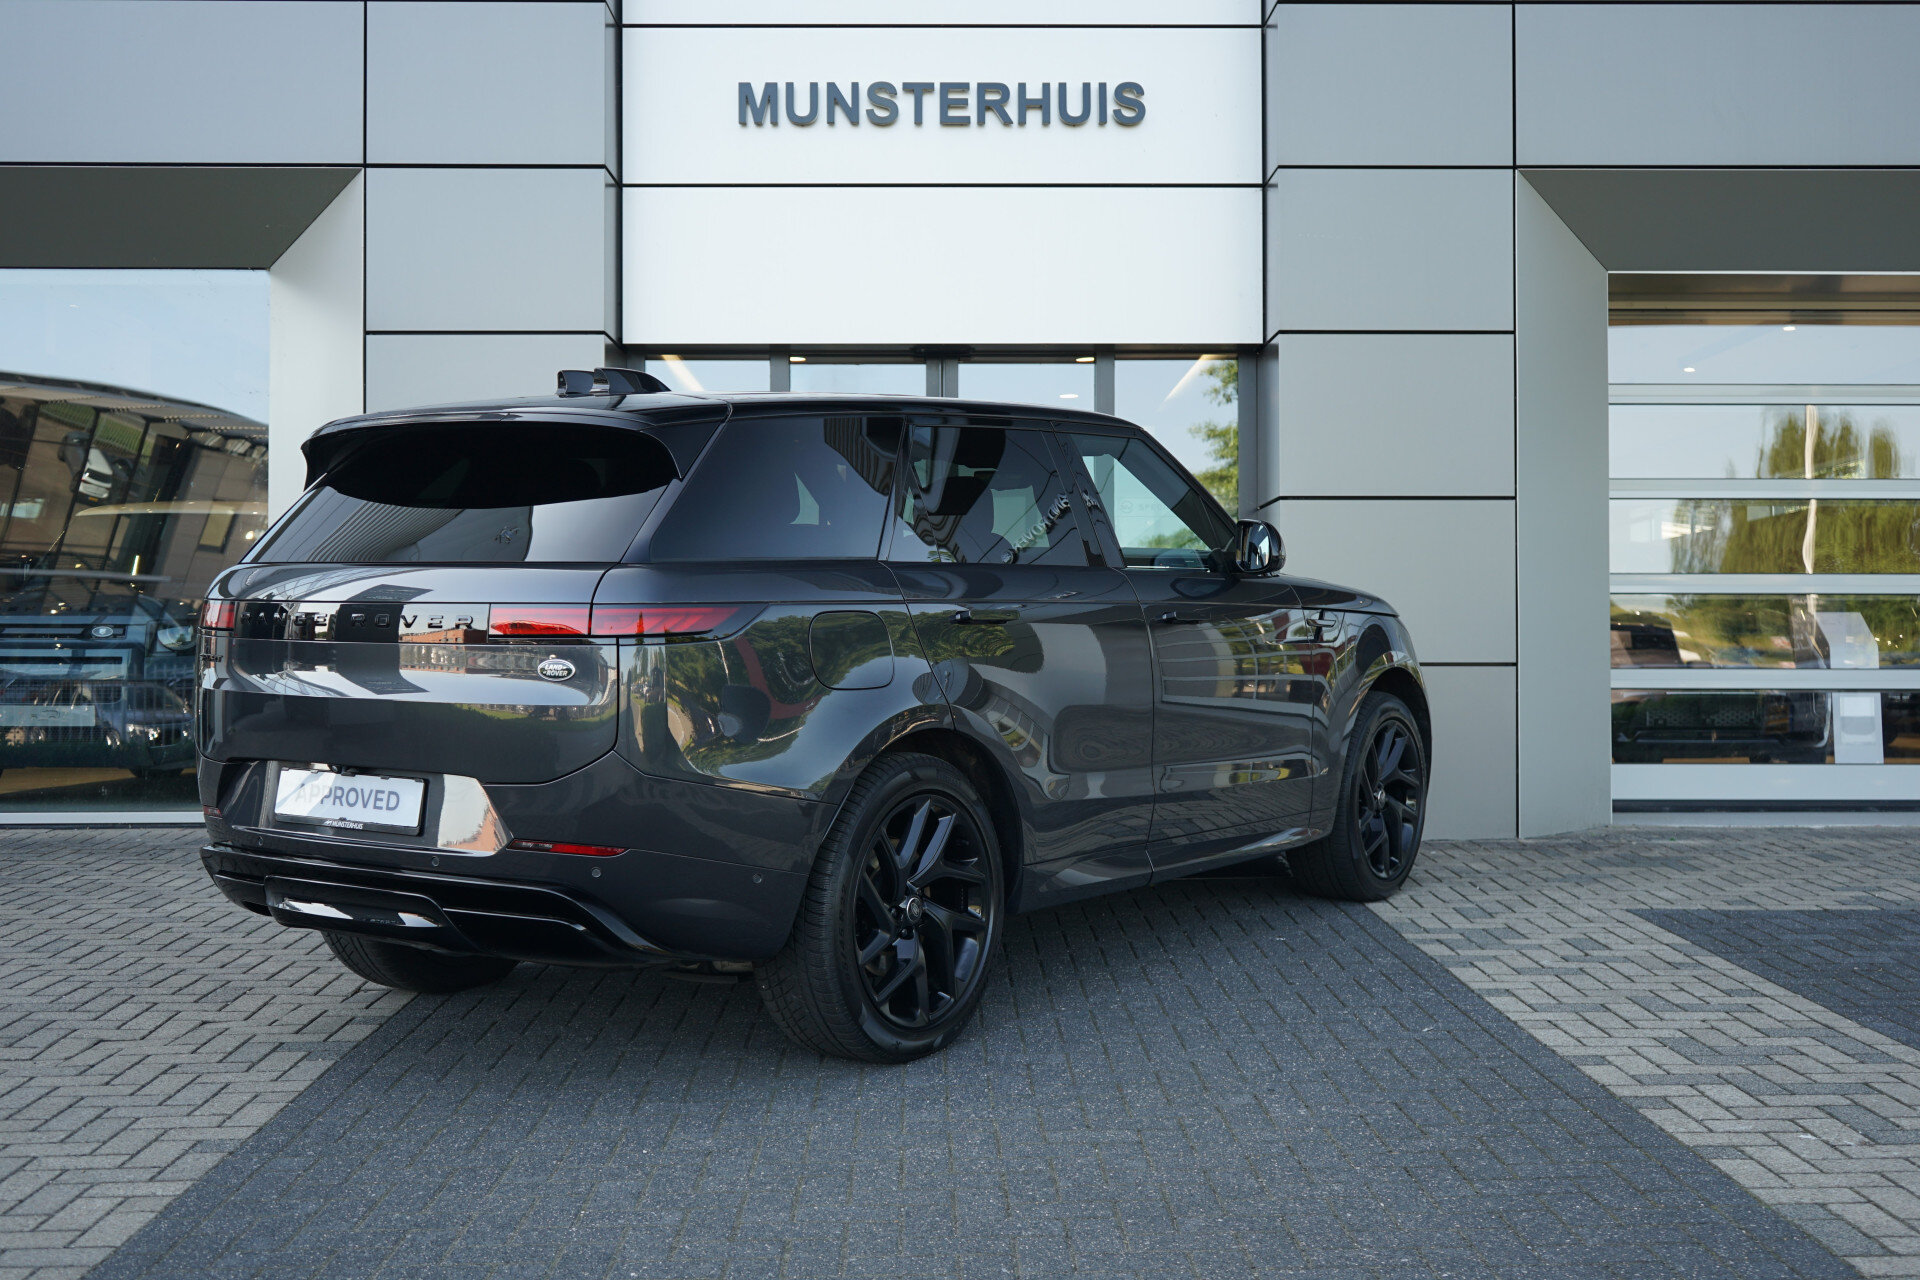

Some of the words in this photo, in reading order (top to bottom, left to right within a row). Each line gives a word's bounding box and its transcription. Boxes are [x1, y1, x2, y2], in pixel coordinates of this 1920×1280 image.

[738, 81, 1147, 127] MUNSTERHUIS
[240, 611, 328, 627] RANGE
[351, 612, 474, 630] ROVER
[296, 782, 401, 812] APPROVED
[331, 820, 365, 830] MUNSTERHUIS
